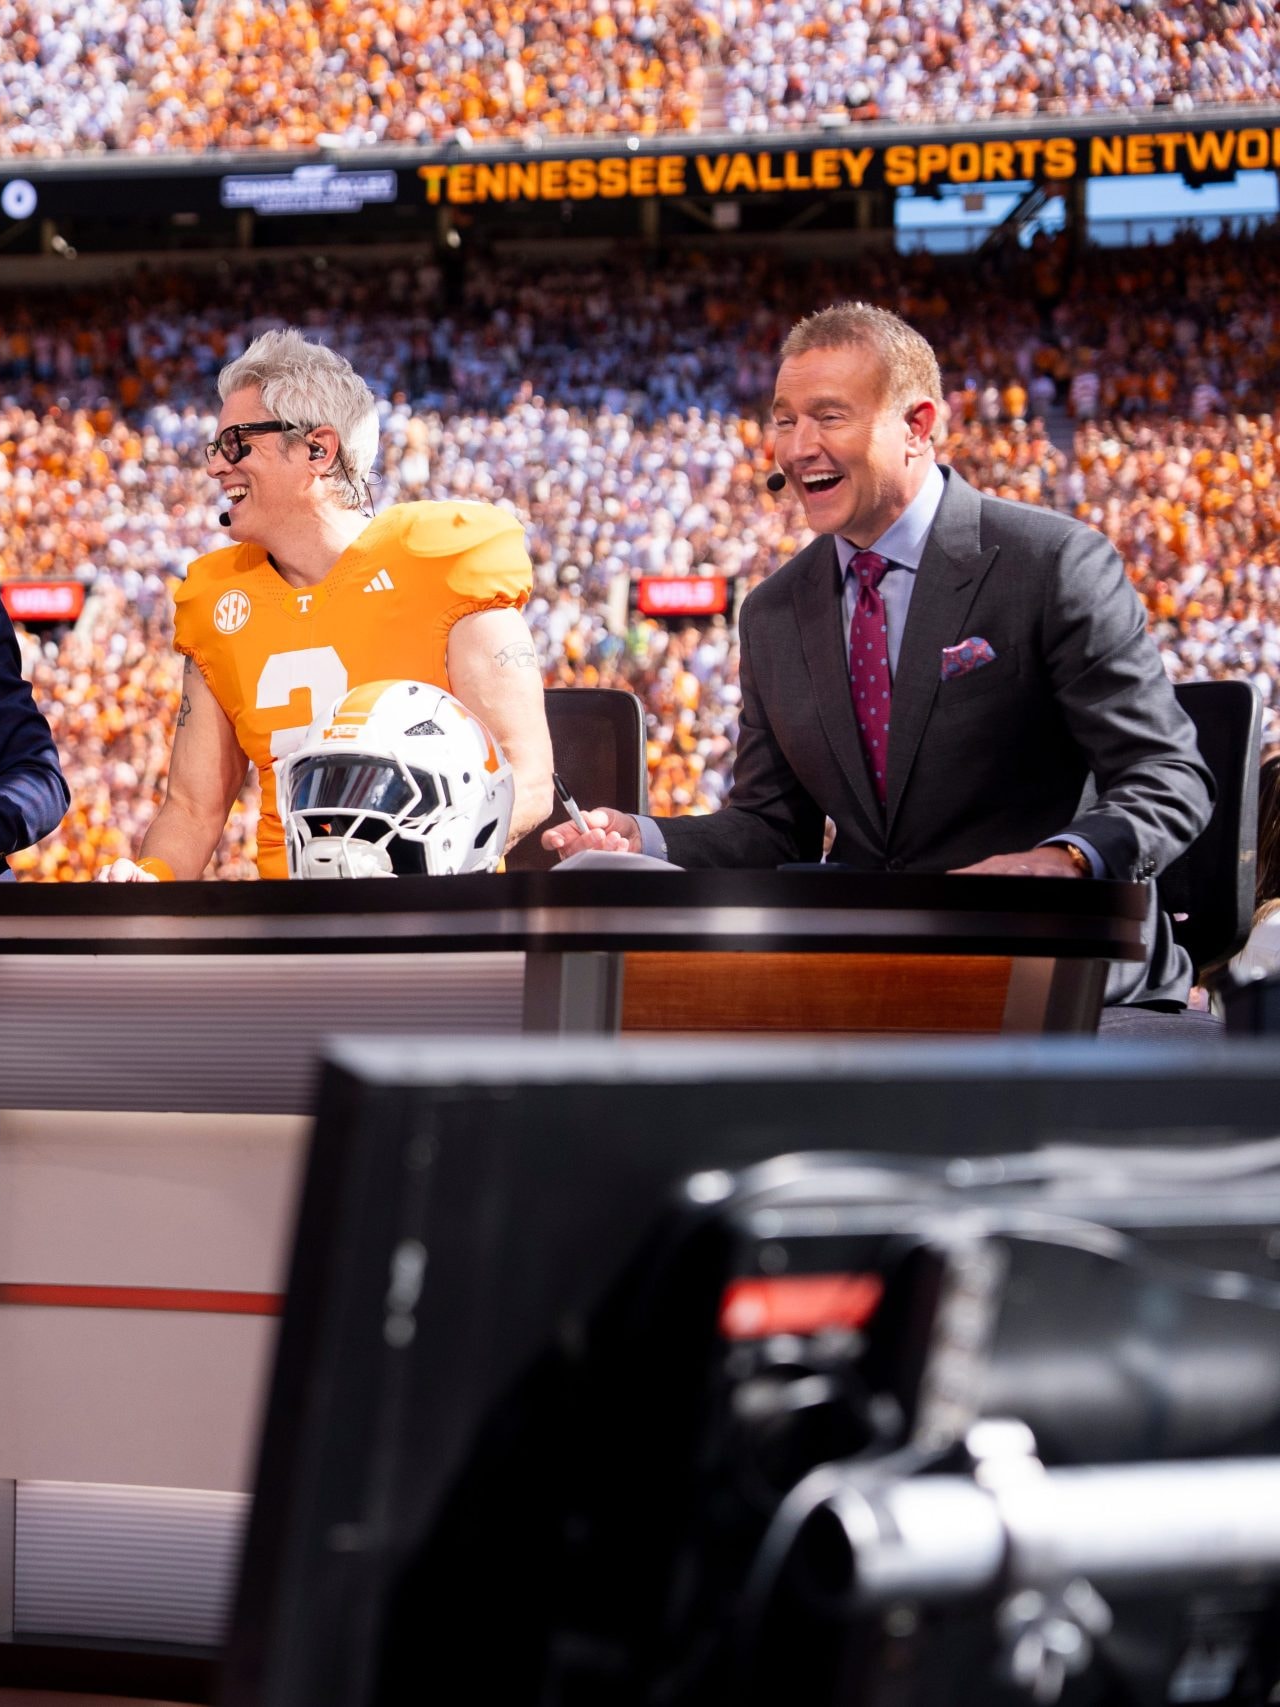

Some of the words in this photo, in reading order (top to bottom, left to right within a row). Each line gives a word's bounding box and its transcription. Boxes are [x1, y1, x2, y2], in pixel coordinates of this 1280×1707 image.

[419, 155, 686, 203] TENNESSEE
[696, 148, 874, 194] VALLEY
[884, 137, 1077, 184] SPORTS
[1090, 127, 1280, 175] NETWO
[216, 592, 248, 631] SEC
[297, 594, 313, 614] T
